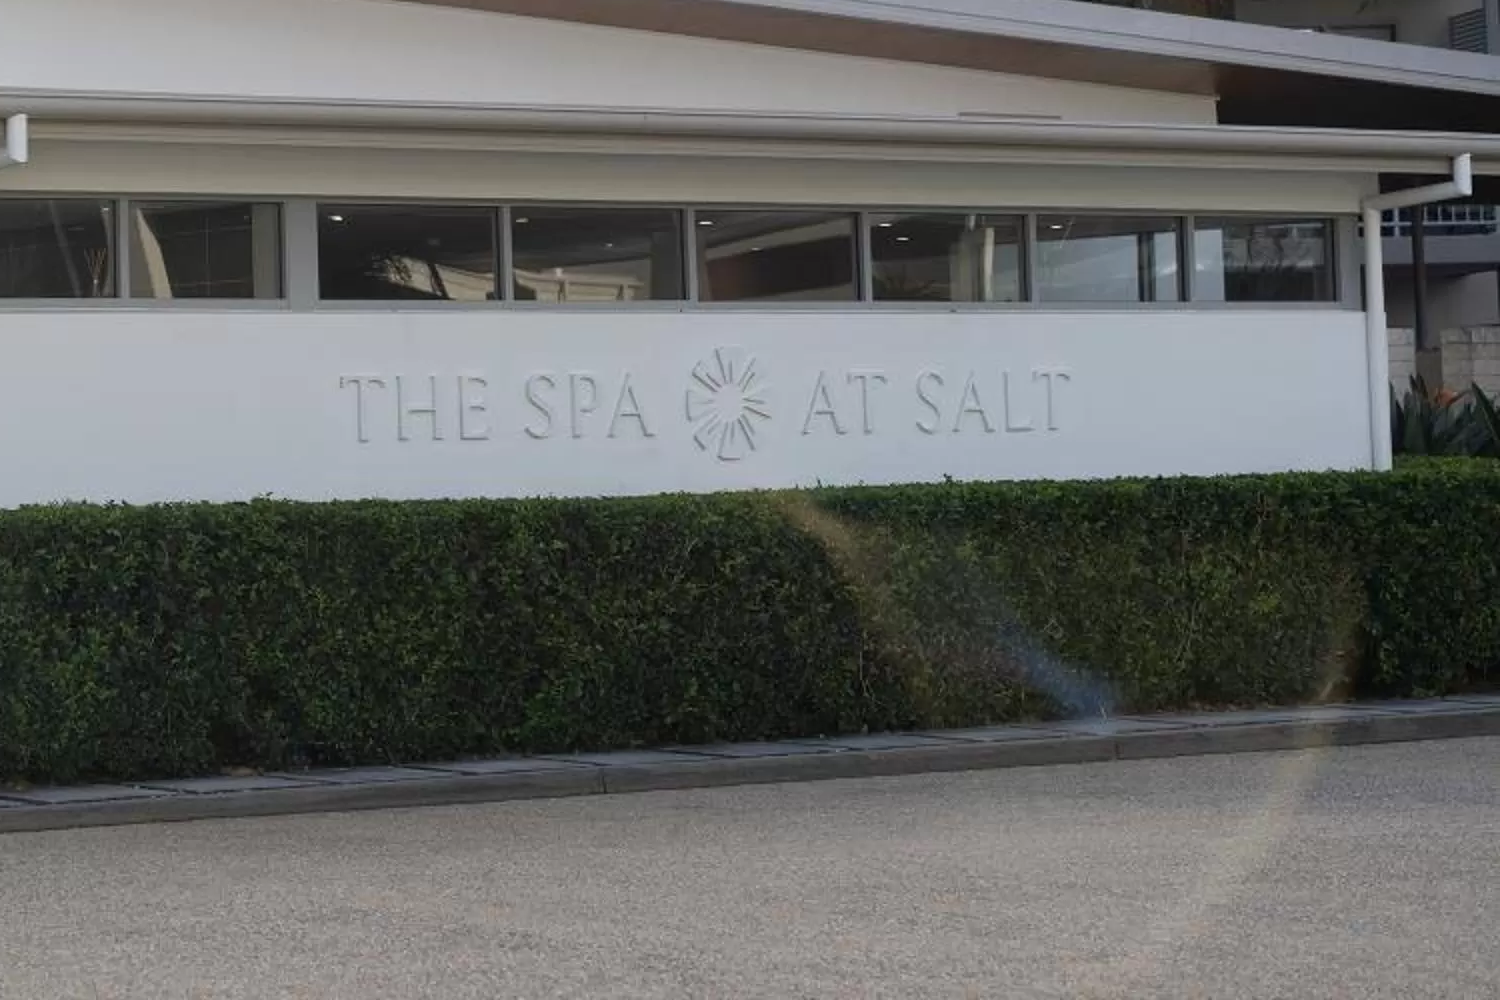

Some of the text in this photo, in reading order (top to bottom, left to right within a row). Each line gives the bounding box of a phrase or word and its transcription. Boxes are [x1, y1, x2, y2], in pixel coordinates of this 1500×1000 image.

[339, 365, 1072, 443] THE SPA AT SALT
